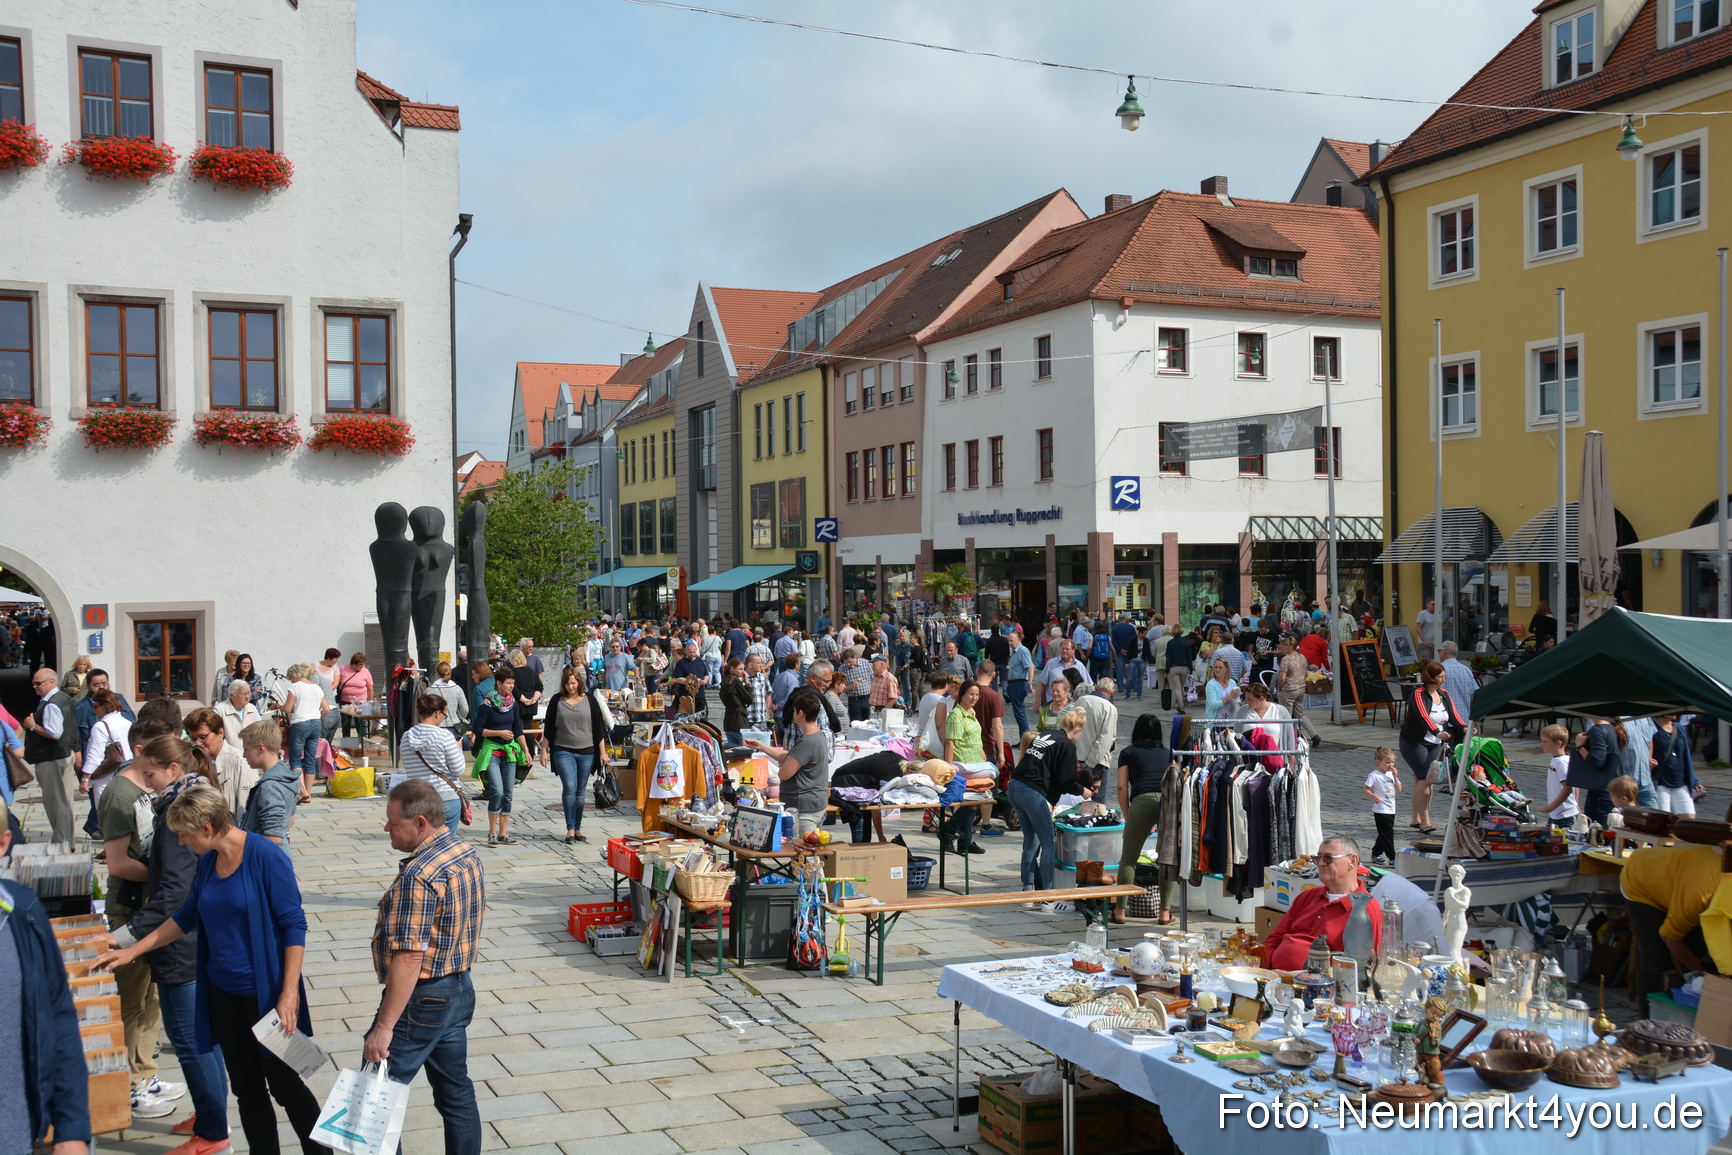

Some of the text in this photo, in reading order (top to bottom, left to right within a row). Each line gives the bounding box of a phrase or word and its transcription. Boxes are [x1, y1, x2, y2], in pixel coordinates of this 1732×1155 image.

[957, 505, 1063, 526] Buchhandlung Rupprecht
[1034, 1107, 1062, 1119] PREMIU
